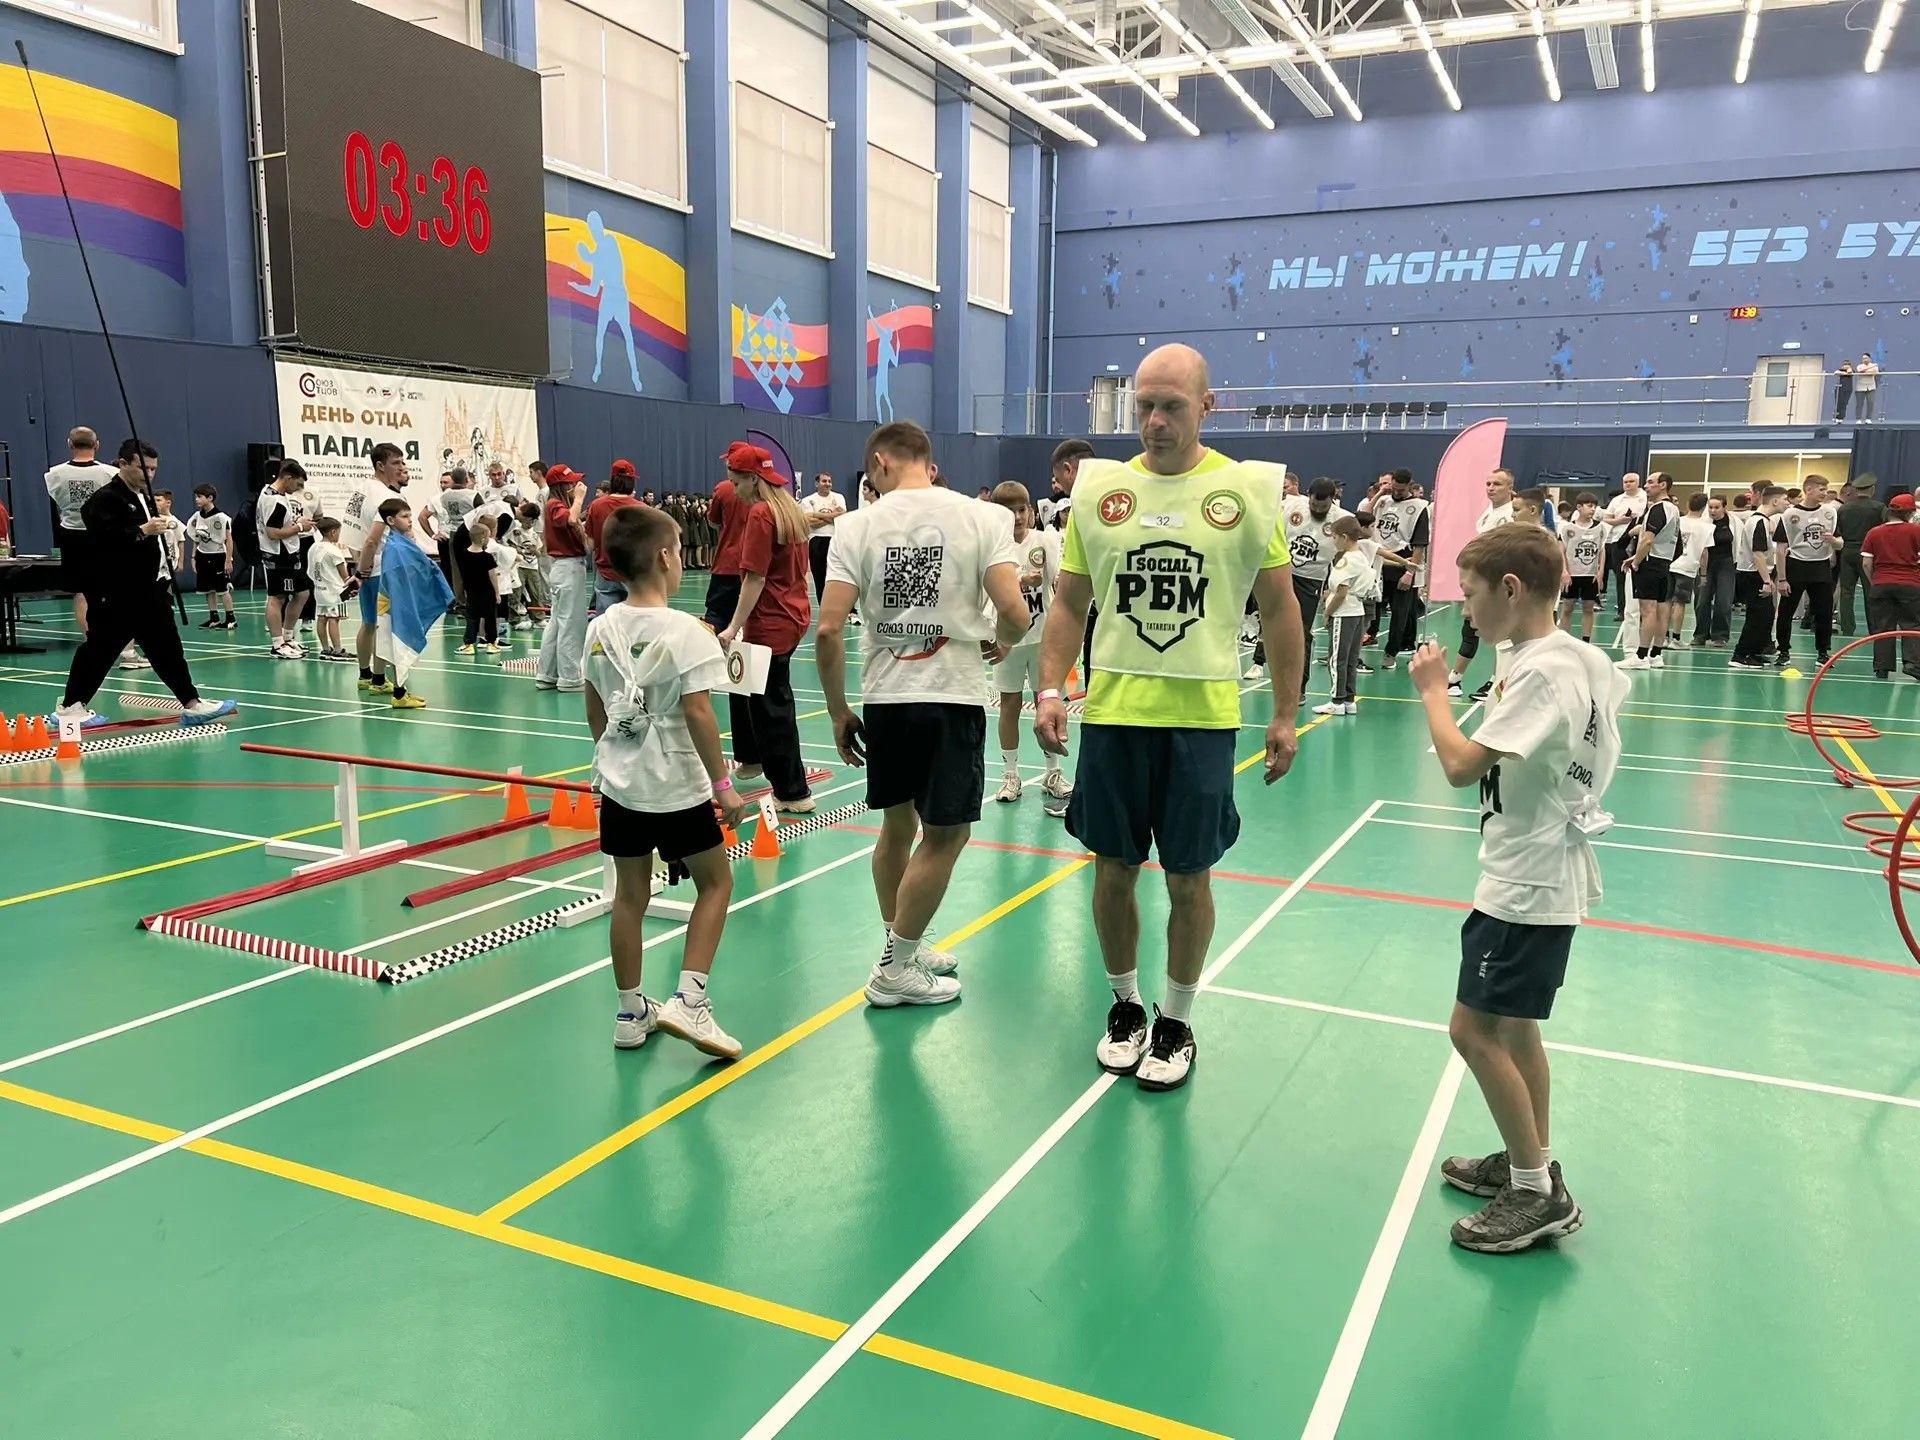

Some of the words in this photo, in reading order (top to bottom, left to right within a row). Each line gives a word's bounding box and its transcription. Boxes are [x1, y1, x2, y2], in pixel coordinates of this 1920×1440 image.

[344, 130, 492, 254] 03:36
[1688, 226, 1809, 267] БЕЗ
[1268, 255, 1349, 290] МЫ
[1364, 240, 1588, 287] МОЖЕМ!
[301, 404, 355, 424] ДЕНЬ
[361, 409, 413, 429] ОТЦА
[303, 433, 375, 458] ПАПА
[405, 440, 420, 461] Я
[1156, 515, 1170, 527] 32
[1376, 519, 1400, 533] РБМ
[1803, 531, 1822, 542] РБ
[1290, 540, 1319, 561] РБМ
[1136, 557, 1192, 574] SOCIAL
[1115, 573, 1209, 619] РБМ
[876, 622, 904, 634] СОЮЗ
[906, 623, 944, 636] ОТЦОВ
[66, 723, 74, 736] 5
